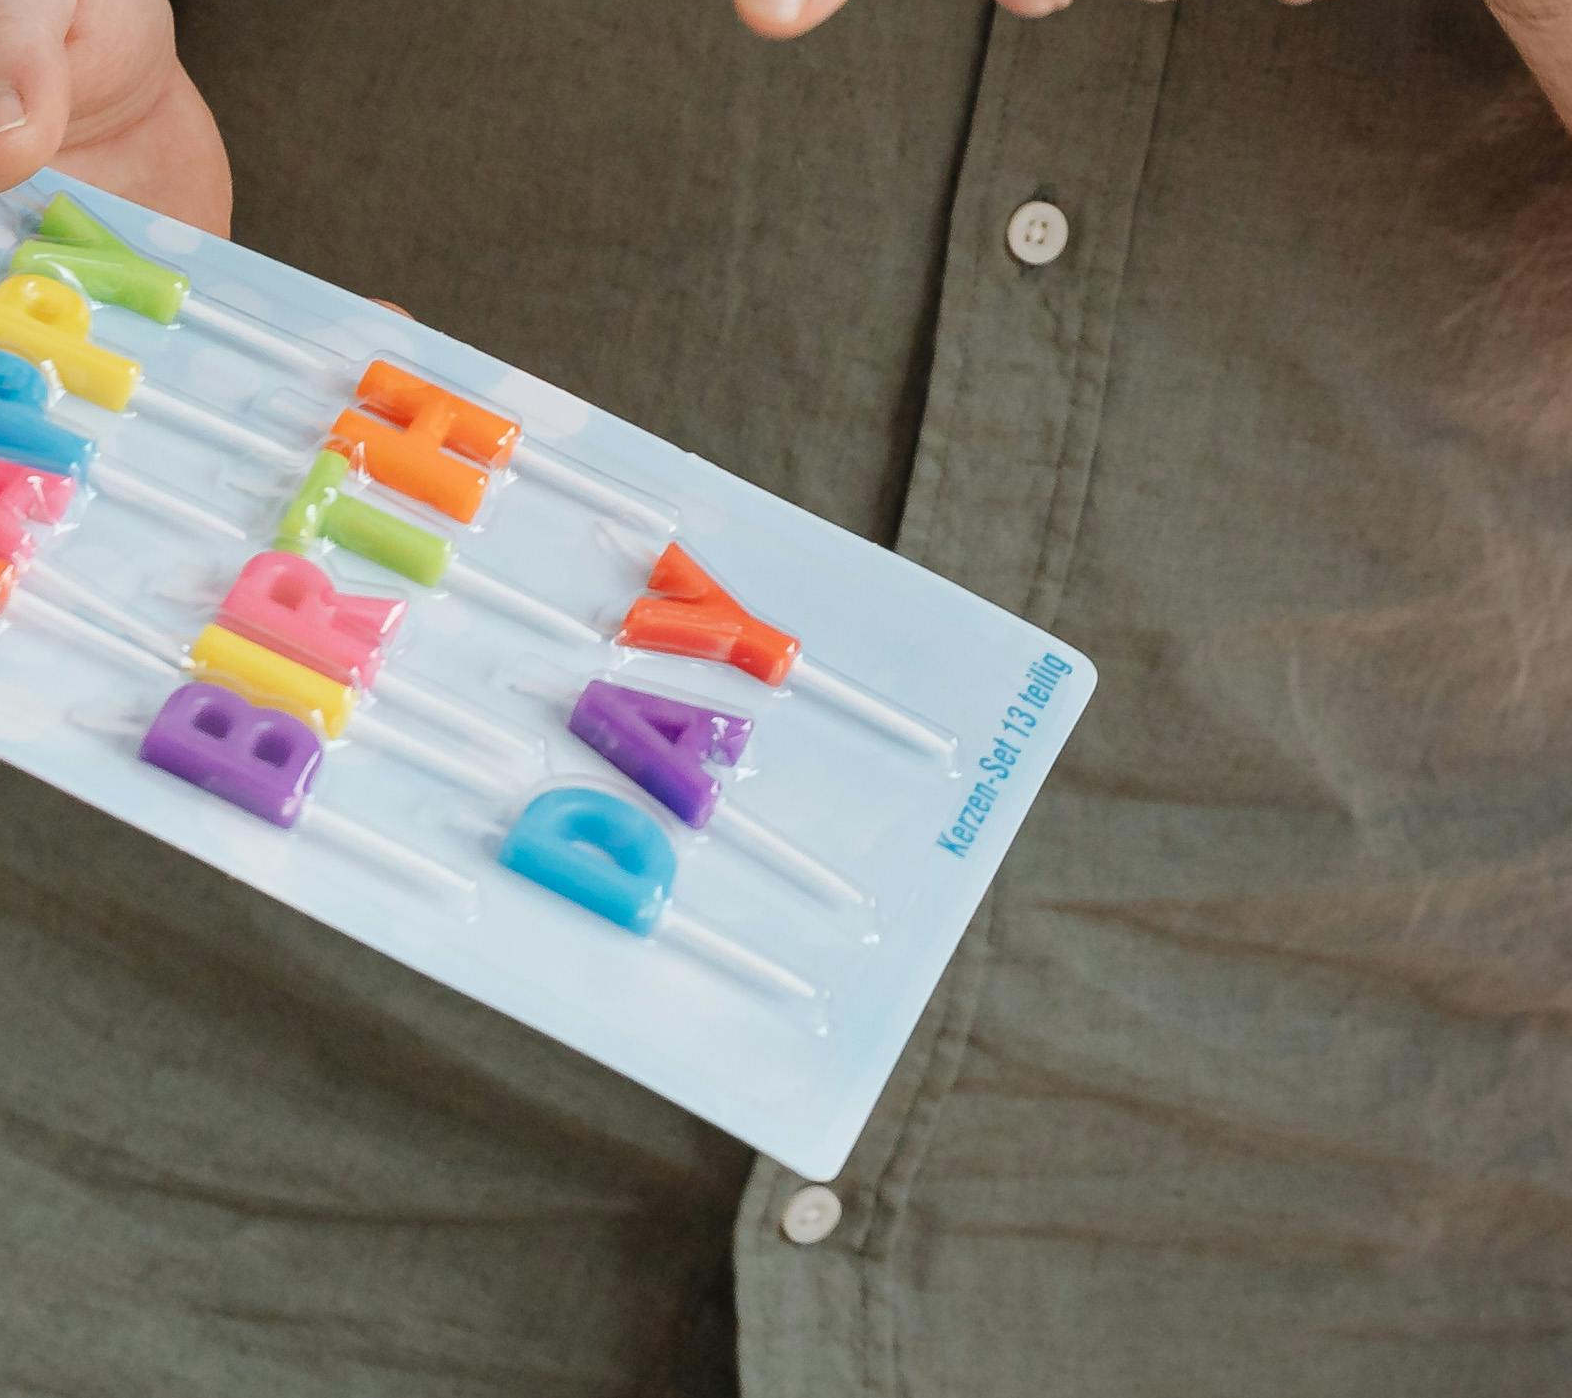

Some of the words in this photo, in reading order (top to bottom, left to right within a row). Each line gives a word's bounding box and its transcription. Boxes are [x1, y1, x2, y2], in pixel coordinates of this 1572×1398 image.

[137, 359, 522, 830] BIRTH
[499, 541, 801, 937] DAY
[1002, 705, 1037, 737] 13
[1018, 653, 1073, 709] teilig
[936, 737, 1021, 859] Kerzen-Set
